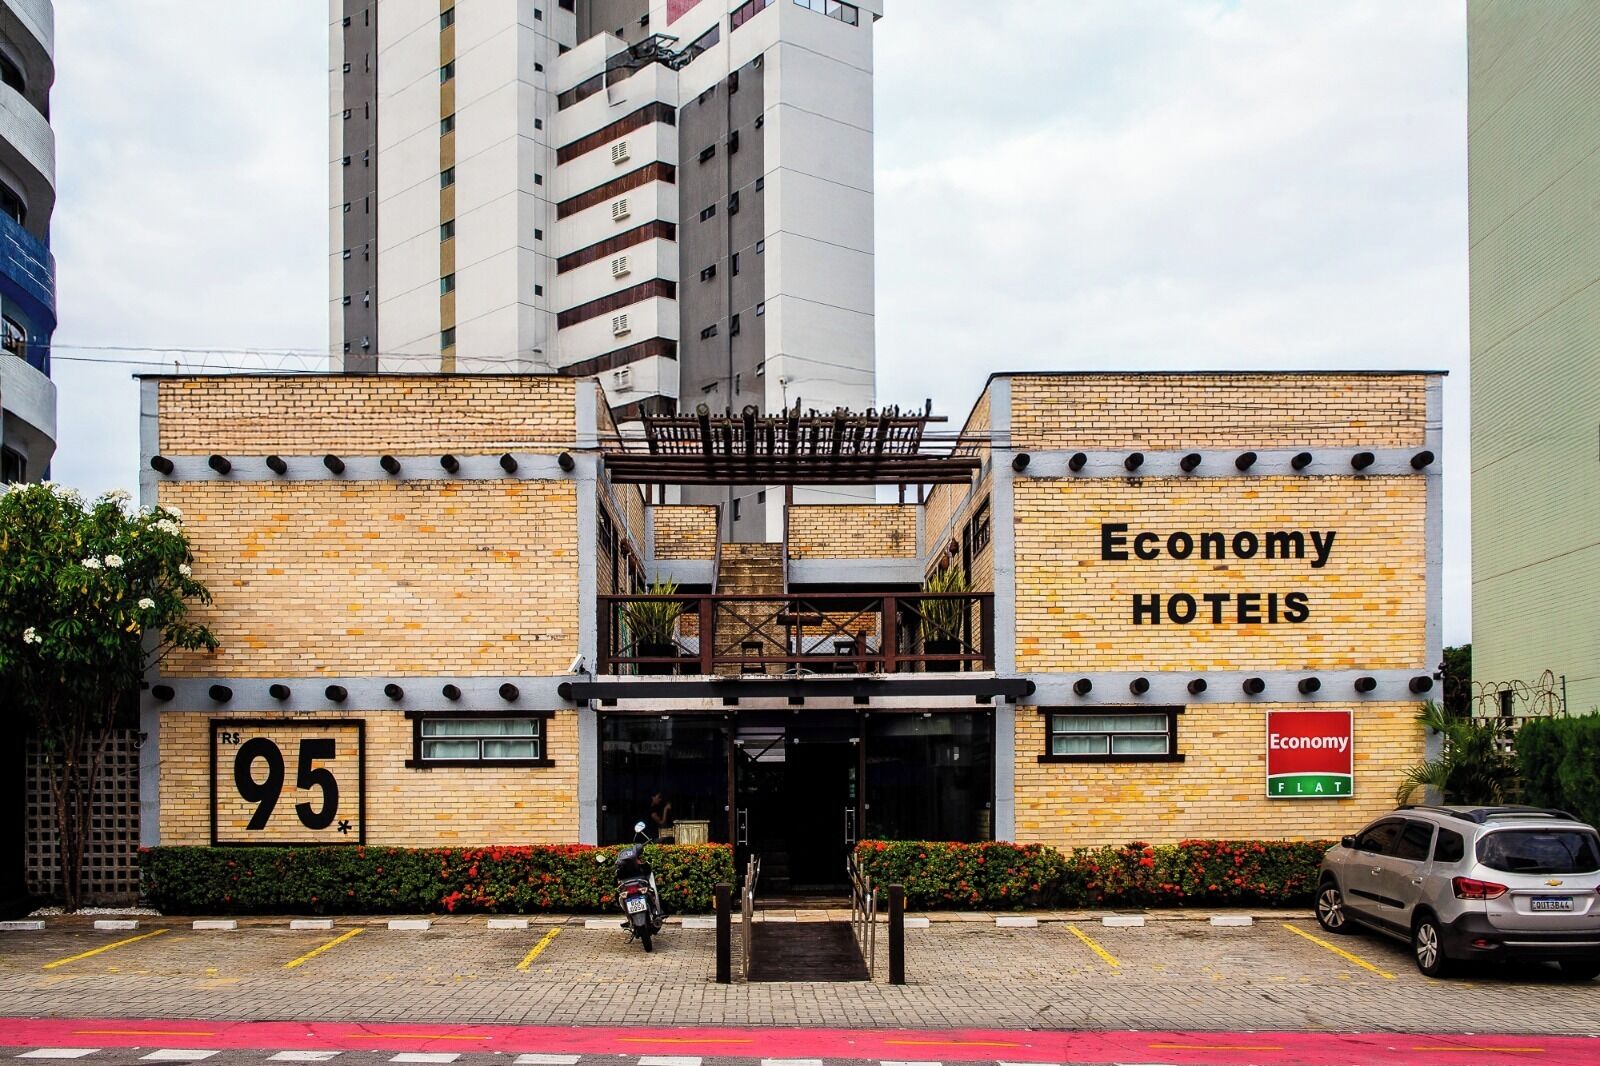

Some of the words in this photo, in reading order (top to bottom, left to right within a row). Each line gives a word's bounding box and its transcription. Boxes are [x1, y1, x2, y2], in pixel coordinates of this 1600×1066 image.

[1101, 523, 1337, 568] Economy
[1133, 592, 1310, 624] HOTEIS
[222, 732, 240, 745] R$
[1270, 733, 1349, 752] Economy
[1278, 782, 1342, 793] FLAT
